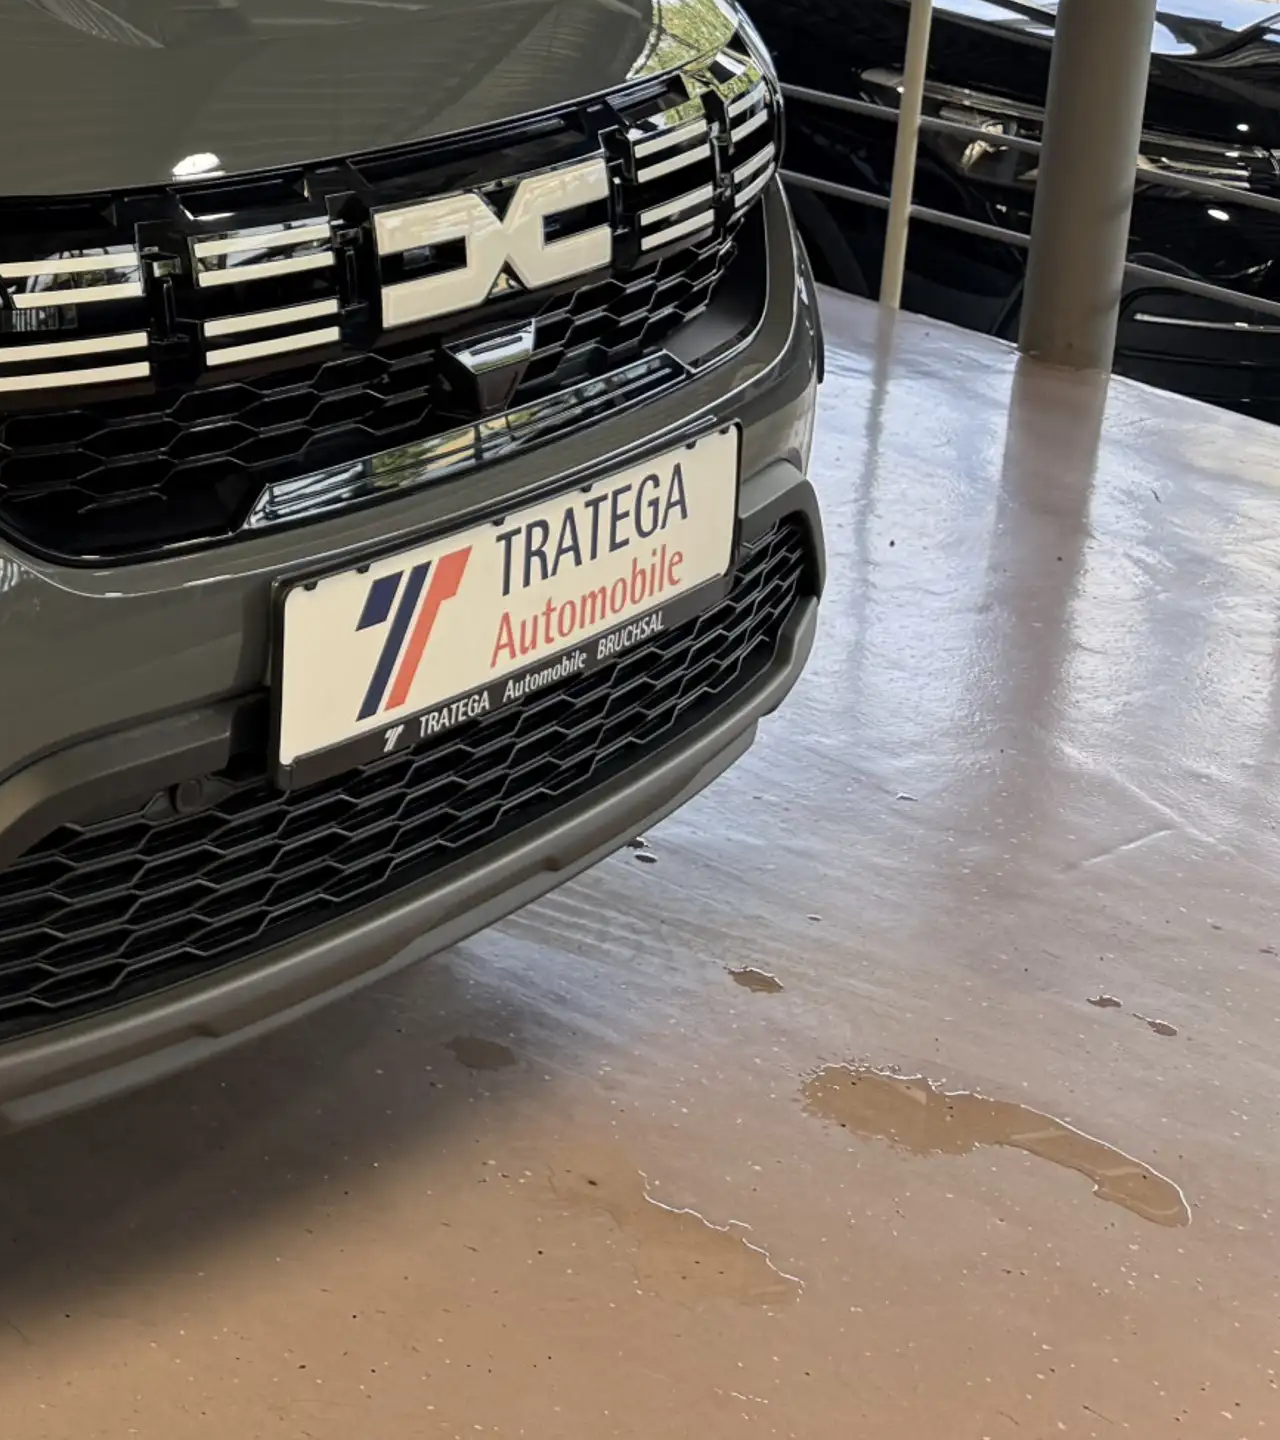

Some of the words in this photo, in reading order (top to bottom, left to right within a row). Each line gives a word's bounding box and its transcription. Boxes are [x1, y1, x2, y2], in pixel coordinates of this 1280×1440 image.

[495, 462, 689, 597] TRATEGA
[490, 544, 684, 669] Automobile
[419, 690, 490, 738] TRATEGA
[502, 650, 587, 703] Automobile
[596, 611, 665, 660] BRUCHSAL
